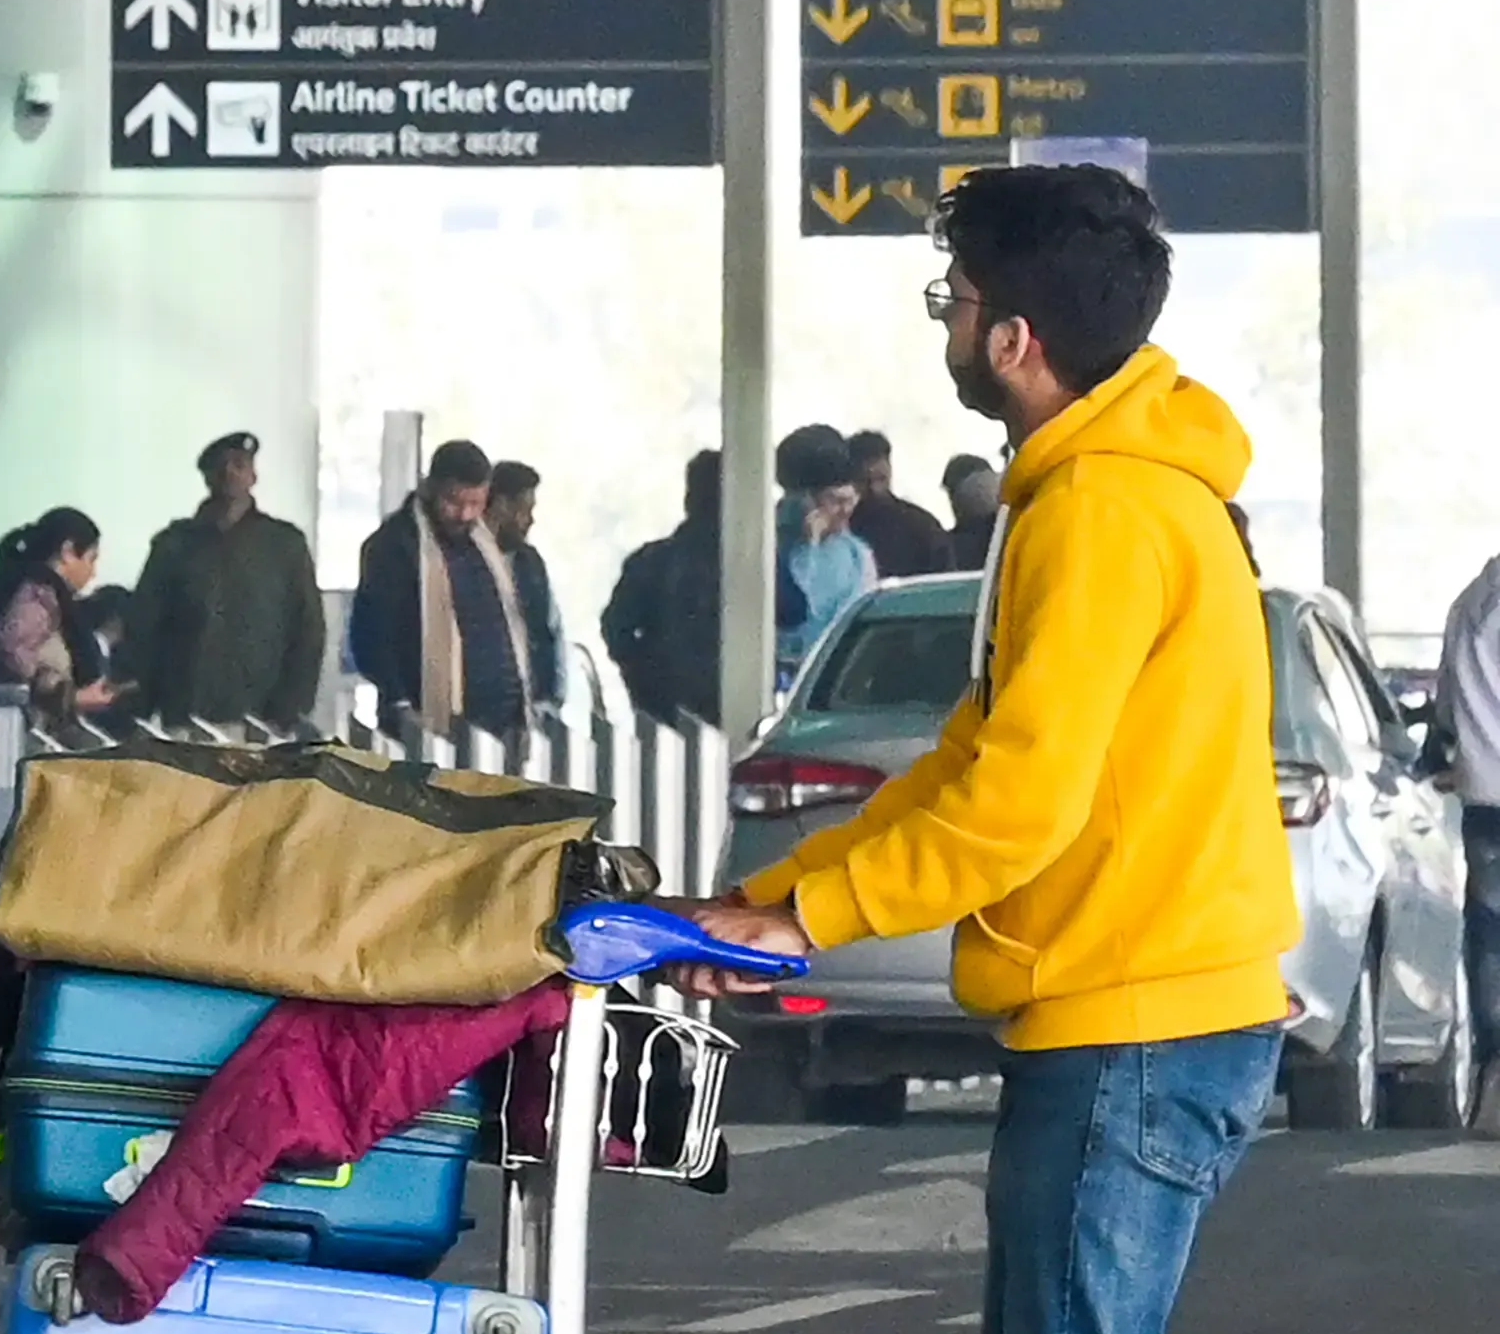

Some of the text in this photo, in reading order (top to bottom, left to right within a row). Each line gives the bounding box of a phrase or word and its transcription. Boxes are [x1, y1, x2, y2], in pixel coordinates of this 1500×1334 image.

[291, 80, 634, 113] Airline Ticket Counter
